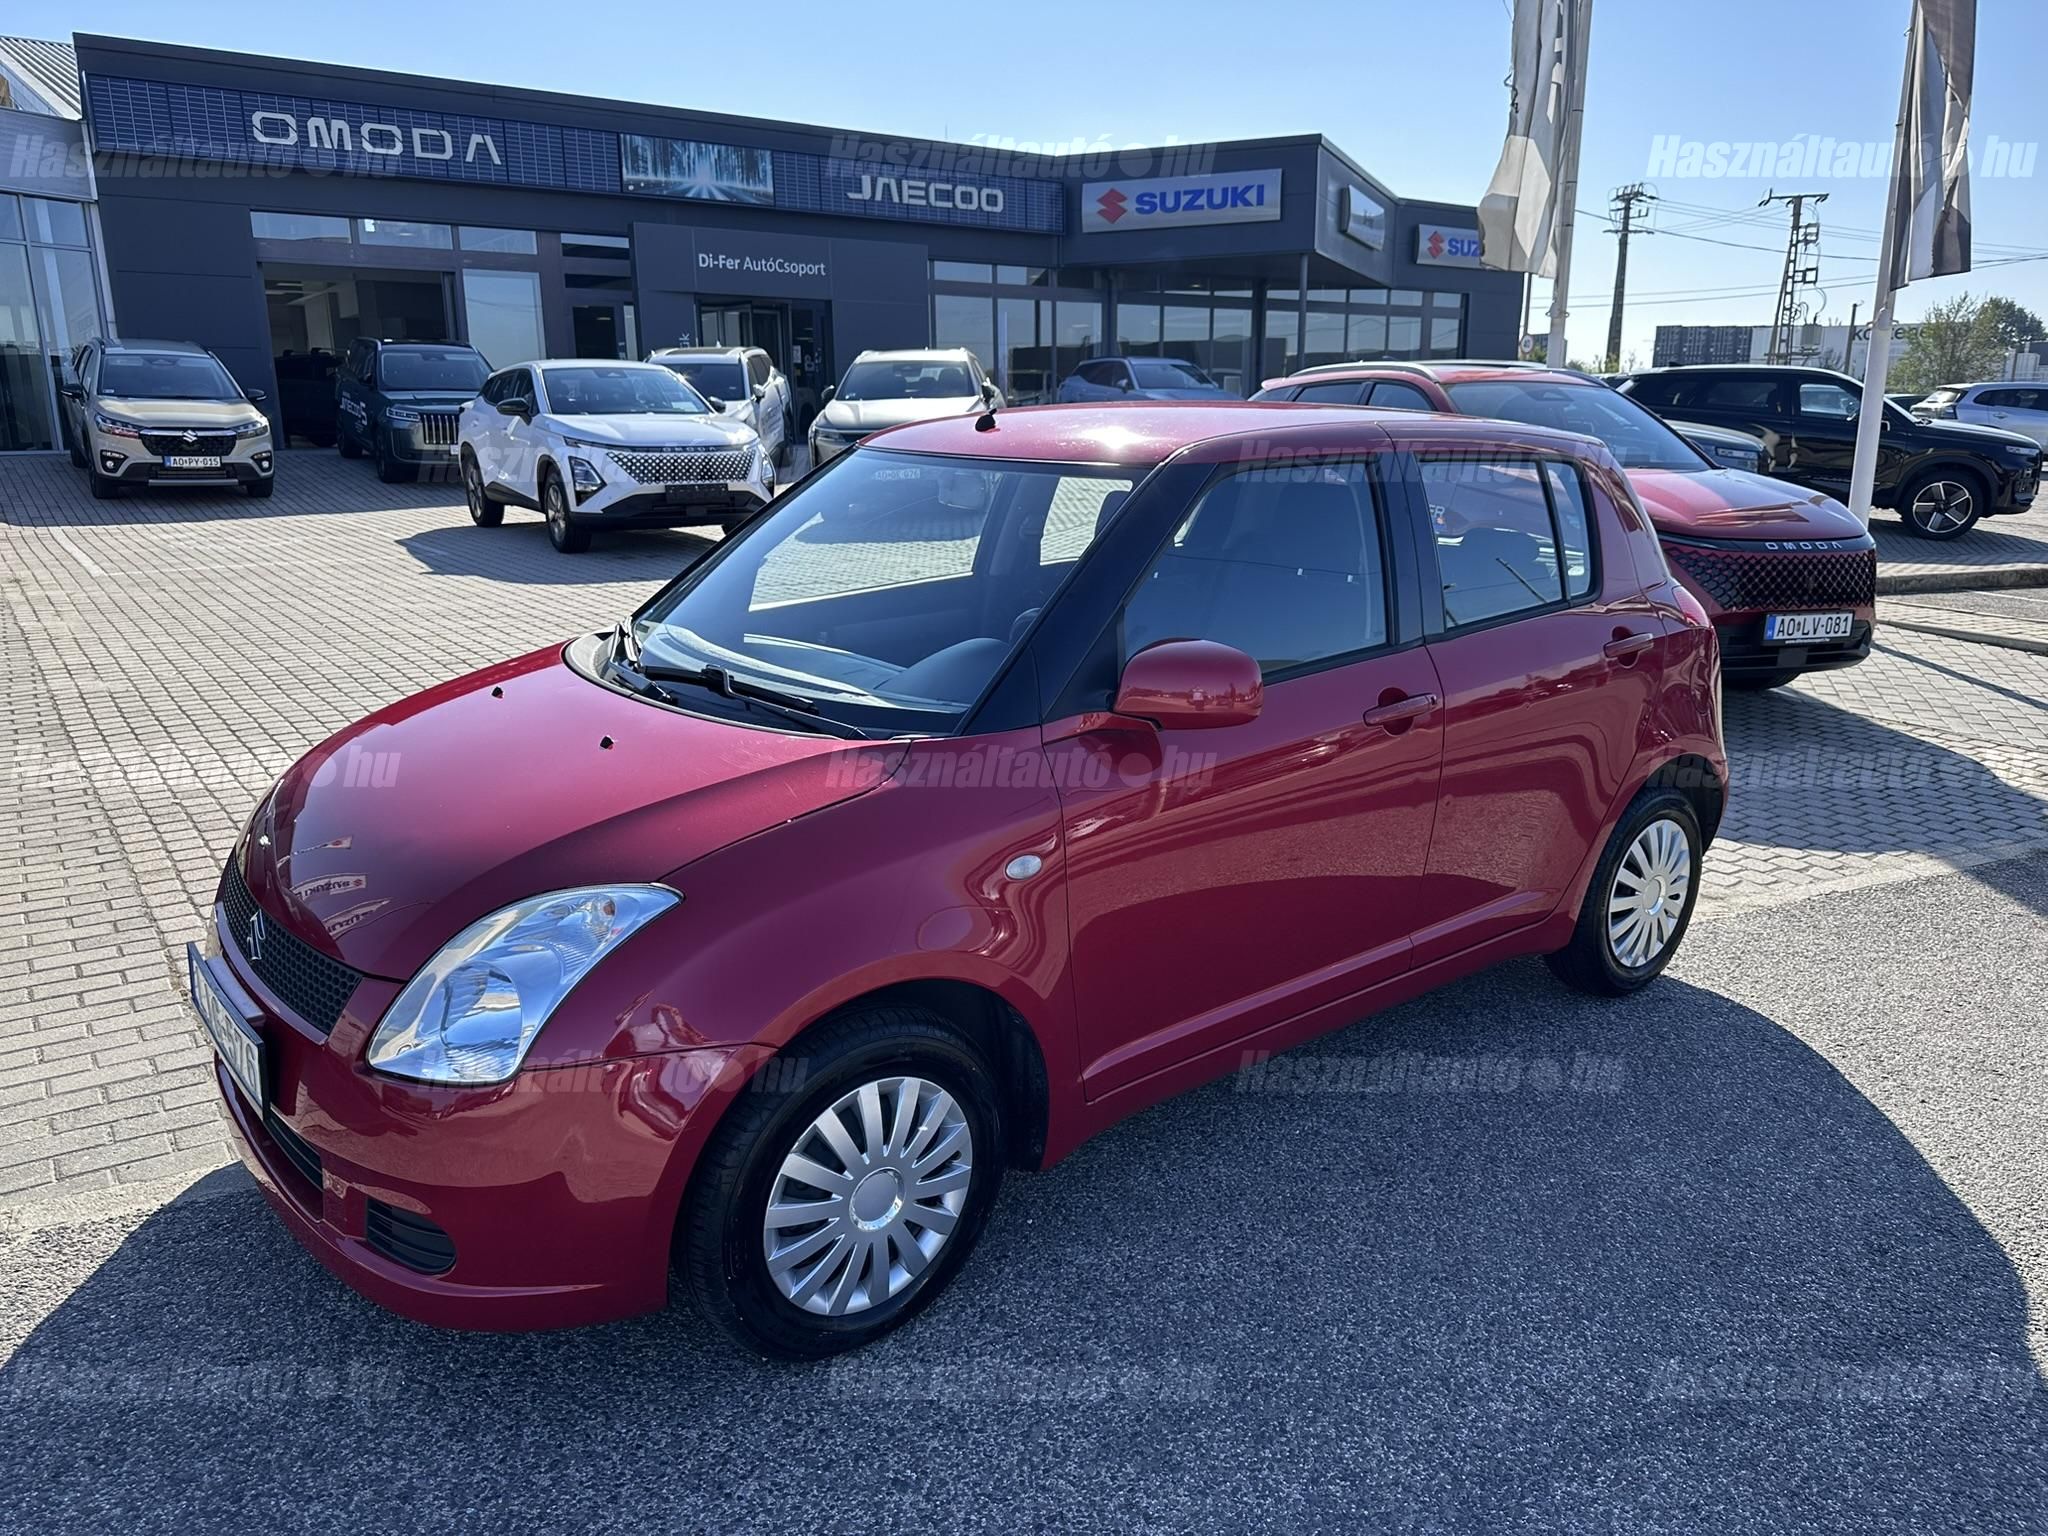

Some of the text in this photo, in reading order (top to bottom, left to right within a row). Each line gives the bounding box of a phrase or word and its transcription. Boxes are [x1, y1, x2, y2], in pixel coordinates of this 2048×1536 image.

[251, 111, 501, 165] OMODA
[846, 175, 1004, 213] JAECOO
[1135, 184, 1265, 215] SUZUKI
[1448, 238, 1480, 257] SUZ
[698, 253, 826, 277] Di-Fer AutóCsoport
[1765, 541, 1842, 550] OMODA
